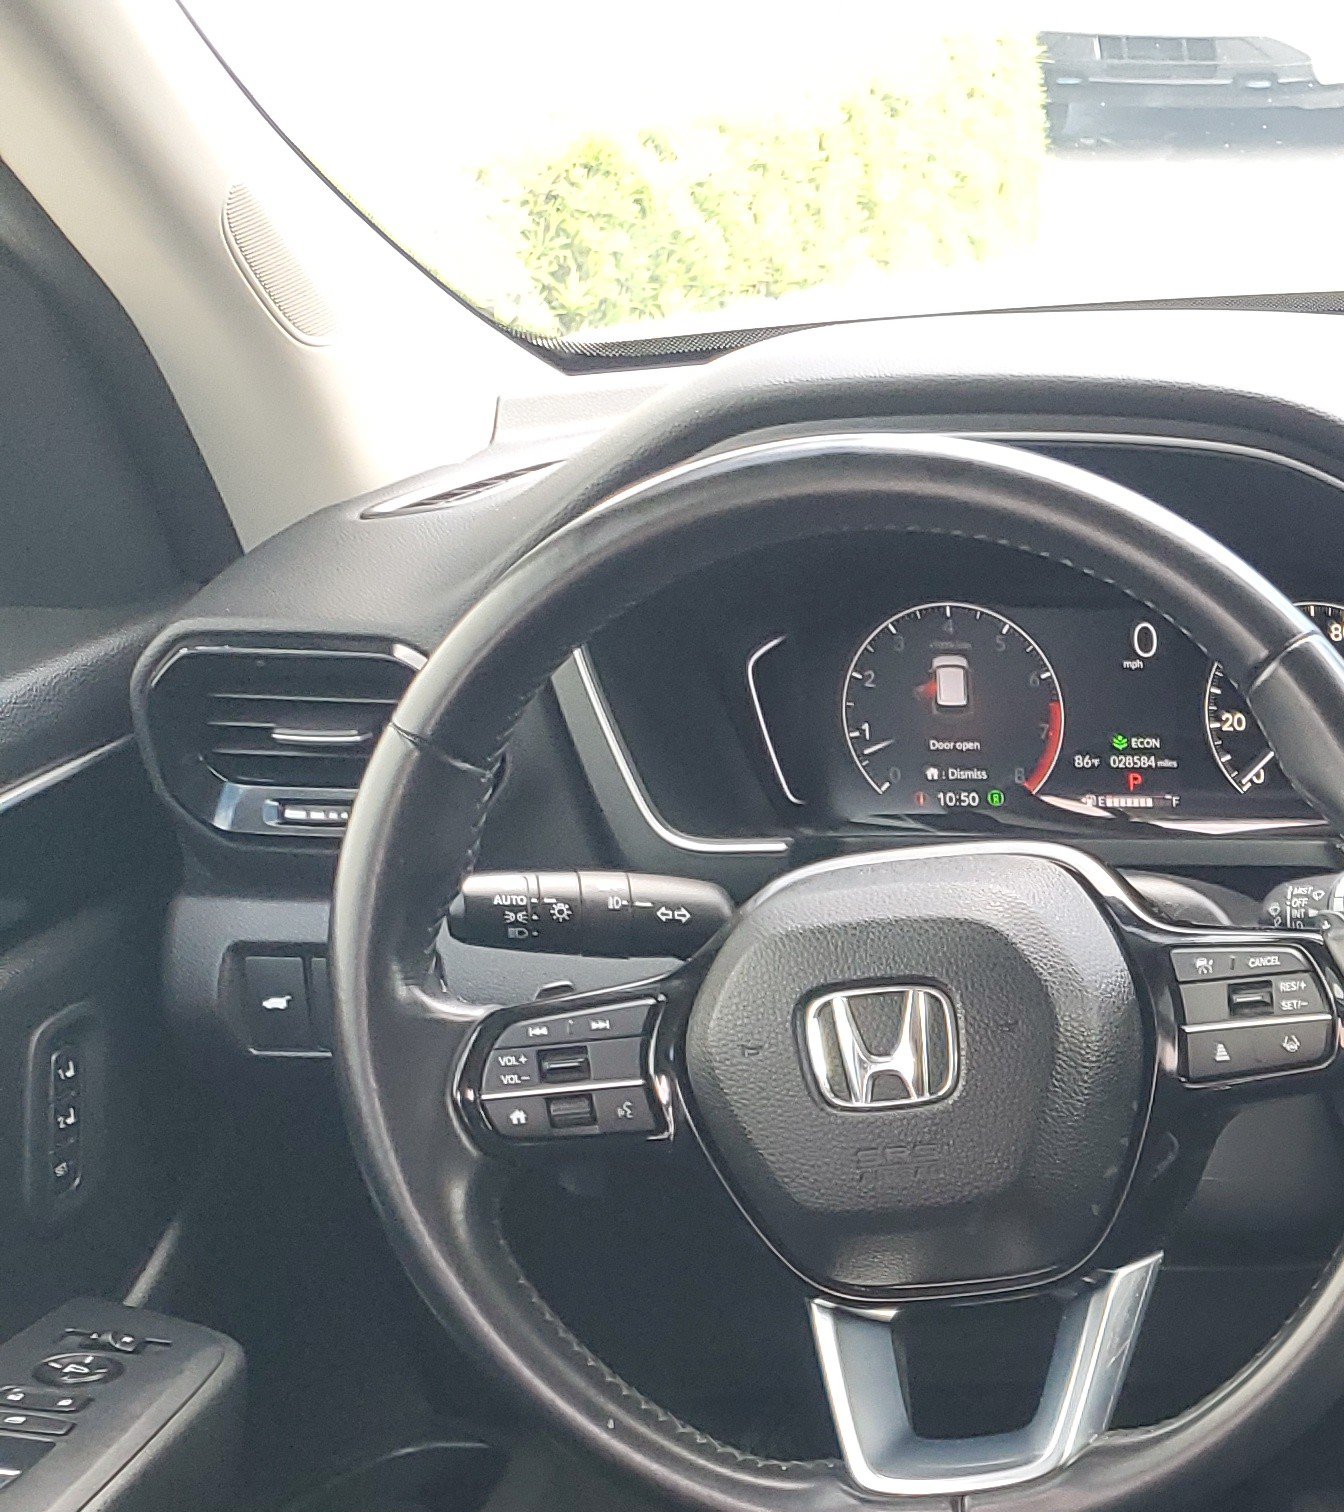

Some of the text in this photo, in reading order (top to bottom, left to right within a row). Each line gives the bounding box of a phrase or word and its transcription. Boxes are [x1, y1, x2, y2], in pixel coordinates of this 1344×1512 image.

[1133, 621, 1158, 658] 0
[1123, 660, 1144, 669] mph
[863, 670, 876, 688] 2
[1221, 712, 1246, 731] 20
[861, 722, 870, 740] 1
[929, 740, 981, 752] Door open
[1131, 738, 1161, 749] ECON
[1110, 755, 1156, 768] 028584
[948, 769, 988, 780] Dismiss
[1128, 773, 1144, 791] P
[937, 791, 980, 806] 10:50
[493, 894, 528, 906] AUTO
[1291, 897, 1309, 908] OFF
[1291, 908, 1305, 918] INT
[1248, 956, 1281, 968] CANCEL
